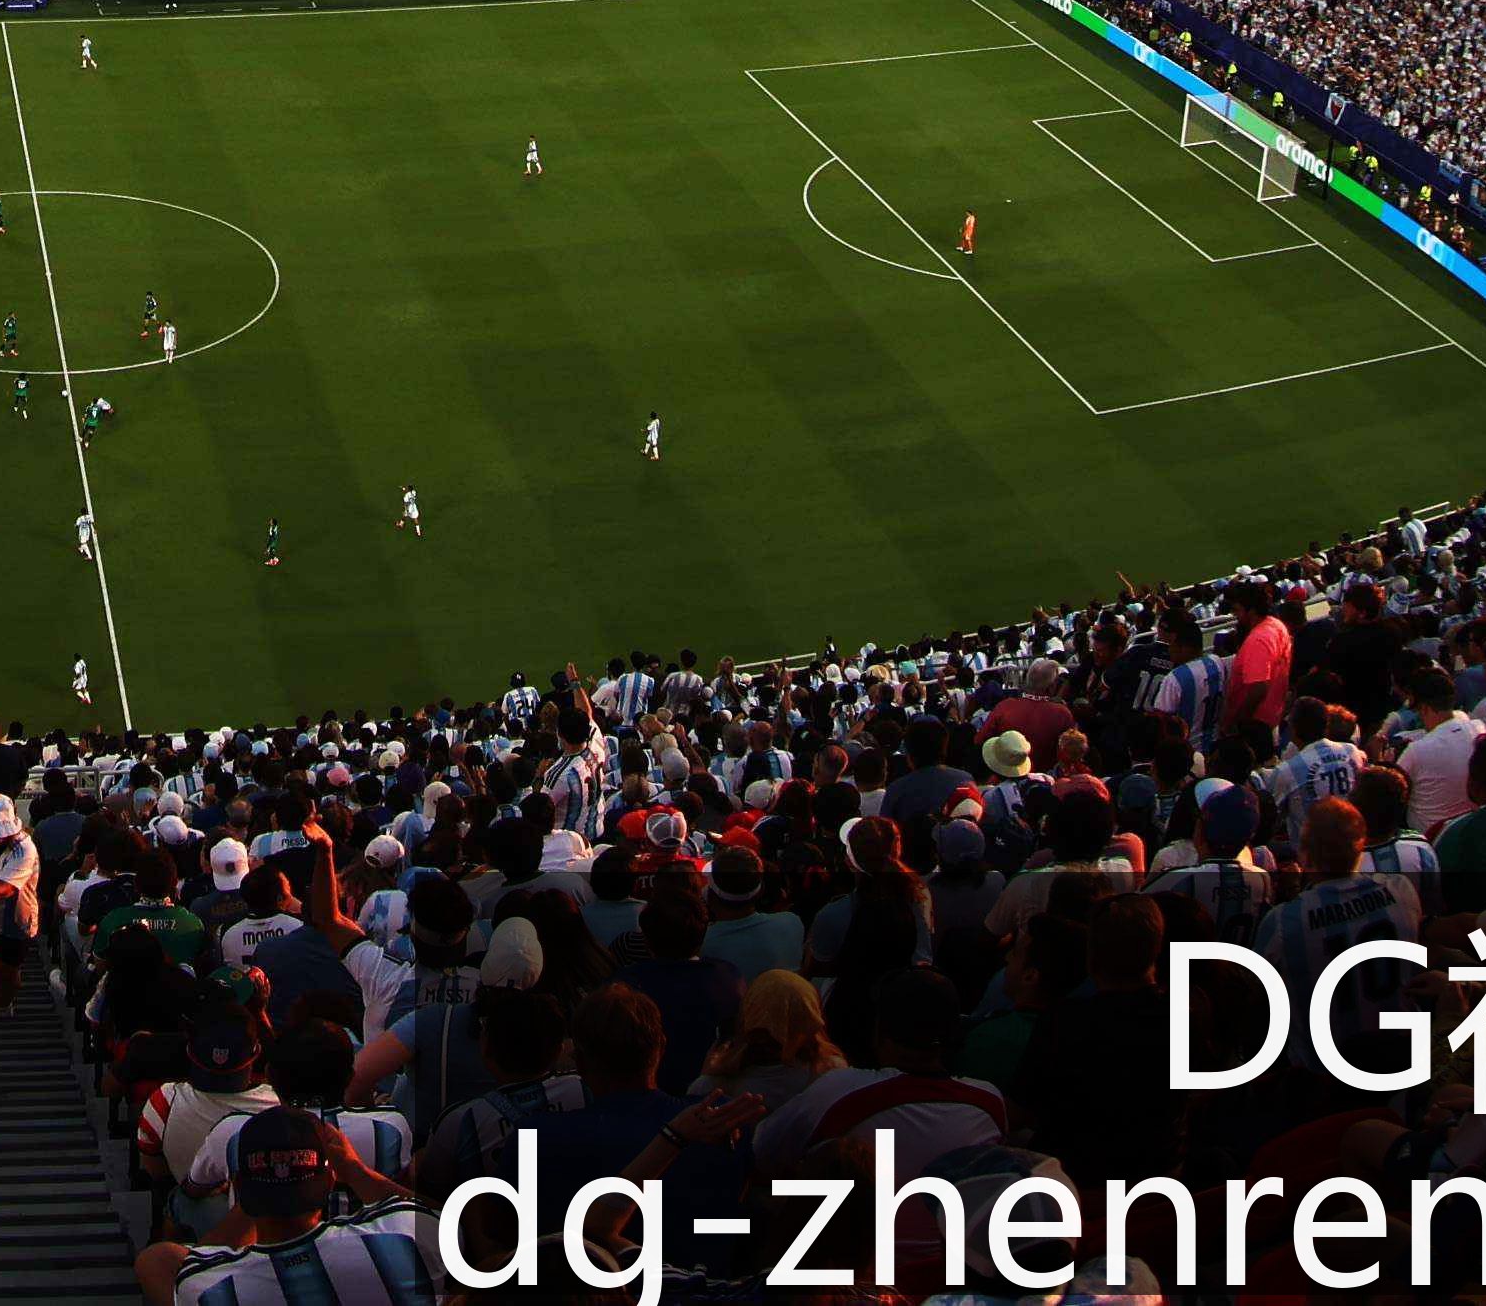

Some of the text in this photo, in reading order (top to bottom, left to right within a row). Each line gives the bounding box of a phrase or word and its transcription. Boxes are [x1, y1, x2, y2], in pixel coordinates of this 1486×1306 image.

[1276, 133, 1334, 185] aramco
[1309, 886, 1396, 931] MARADONA
[425, 988, 471, 1005] MESSI
